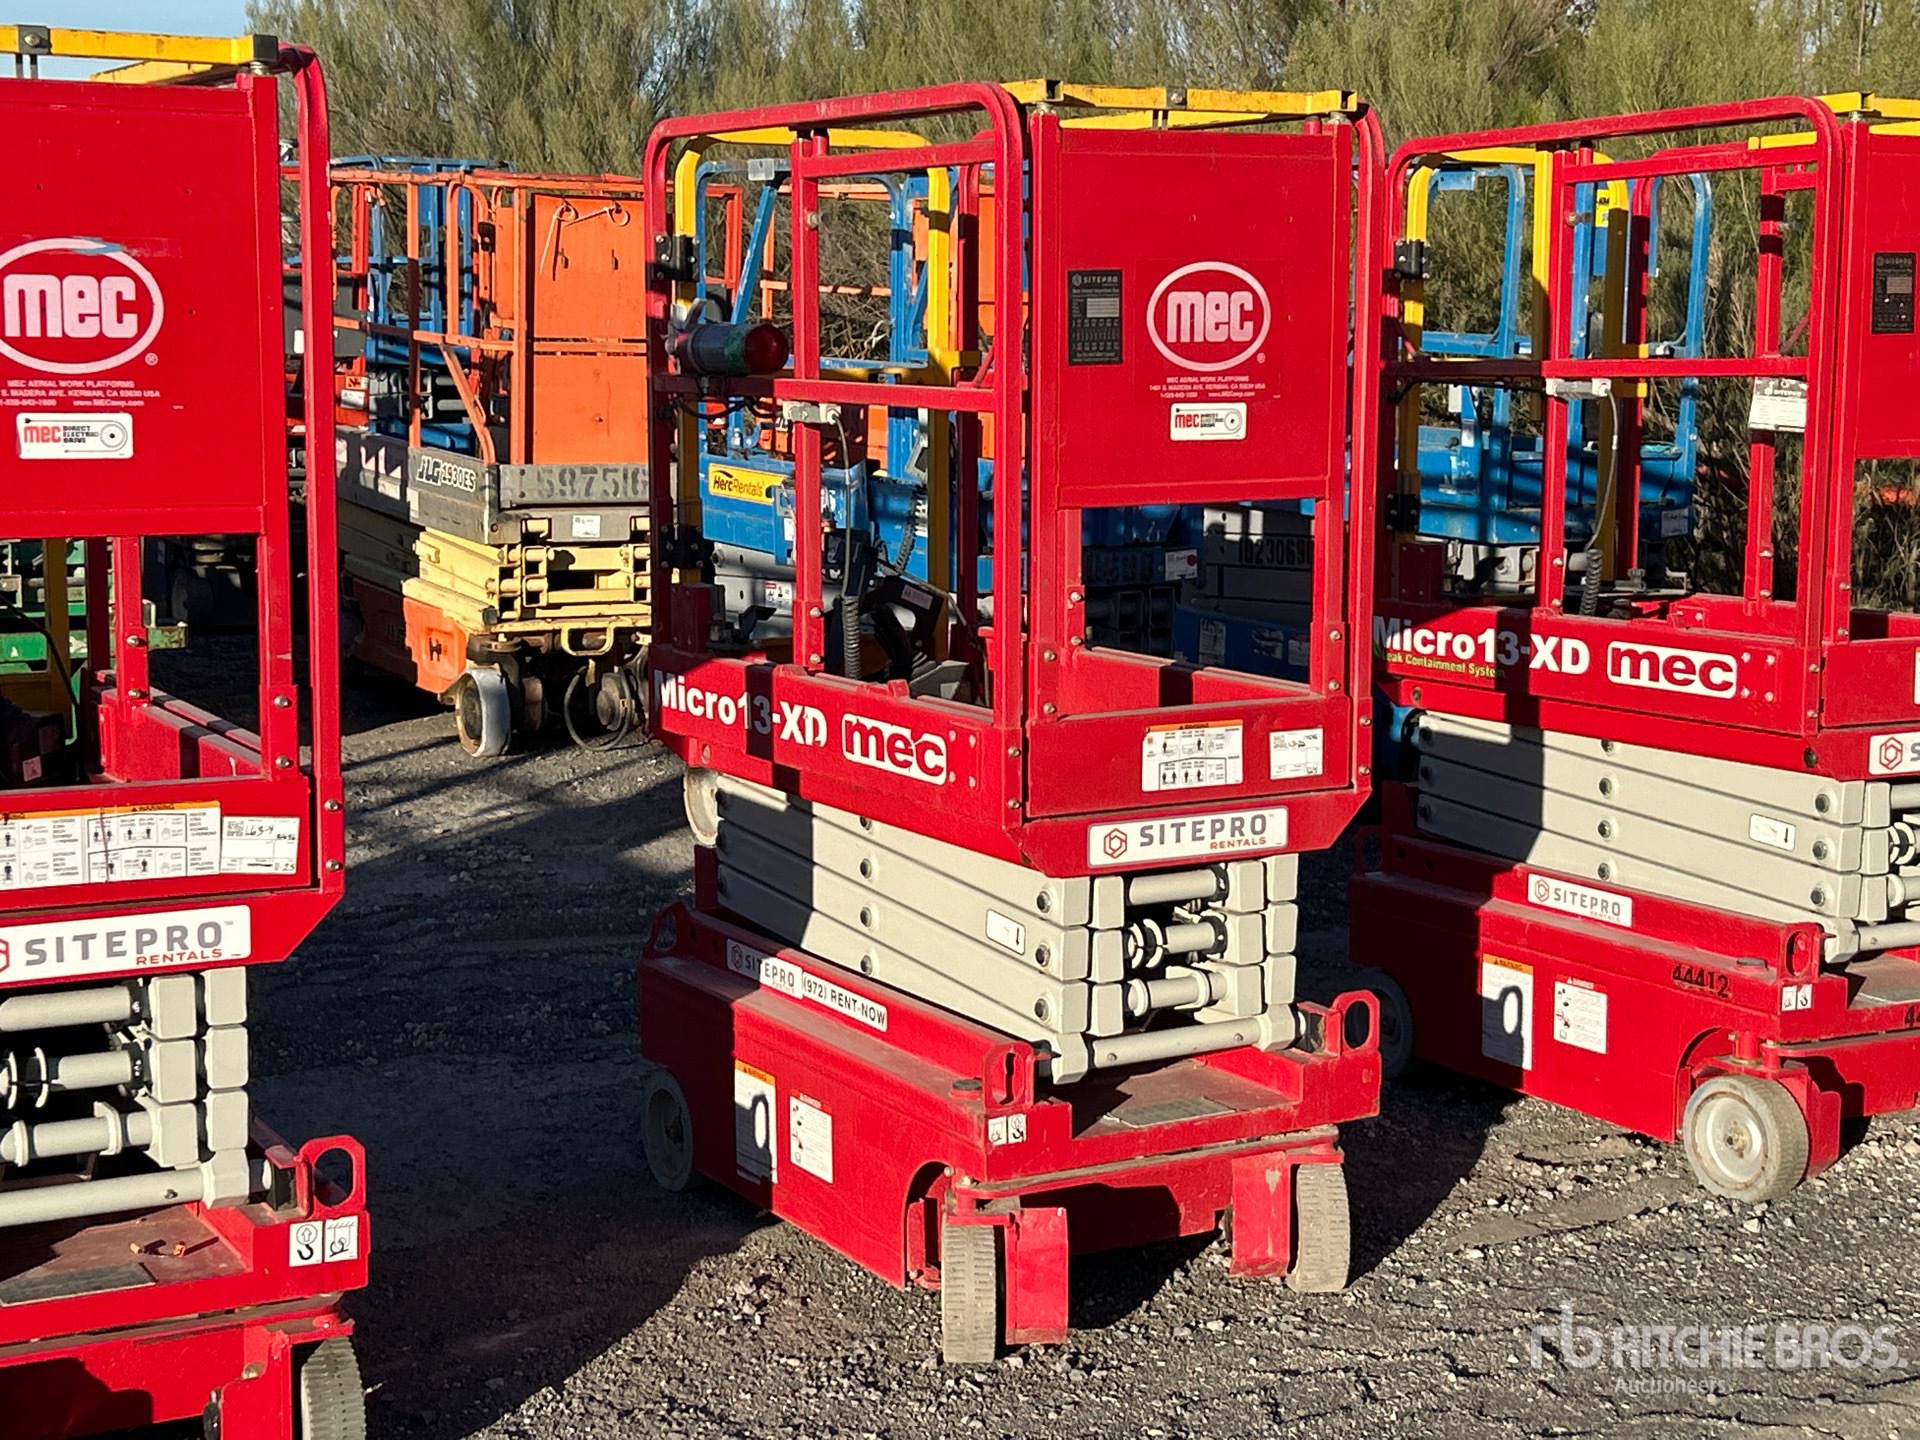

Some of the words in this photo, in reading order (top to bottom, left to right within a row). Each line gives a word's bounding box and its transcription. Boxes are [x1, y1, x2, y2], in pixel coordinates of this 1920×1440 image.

[3, 273, 139, 339] mec
[1166, 290, 1254, 343] mec
[416, 455, 442, 486] JLG
[1373, 615, 1590, 675] Micro13-XD
[1405, 654, 1466, 673] Containment
[1611, 646, 1734, 694] mec
[653, 669, 828, 749] Micro13-XD
[845, 719, 945, 778] mec
[1139, 814, 1267, 847] SITEPRO
[1209, 836, 1267, 850] RENTALS
[1553, 887, 1621, 917] SITEPRO
[25, 921, 223, 967] SITEPRO
[136, 948, 223, 966] RENTALS
[744, 954, 795, 988] SITEPRO
[803, 975, 828, 1001] (972)
[830, 988, 886, 1028] RENT-NOW
[1672, 965, 1730, 998] 44412
